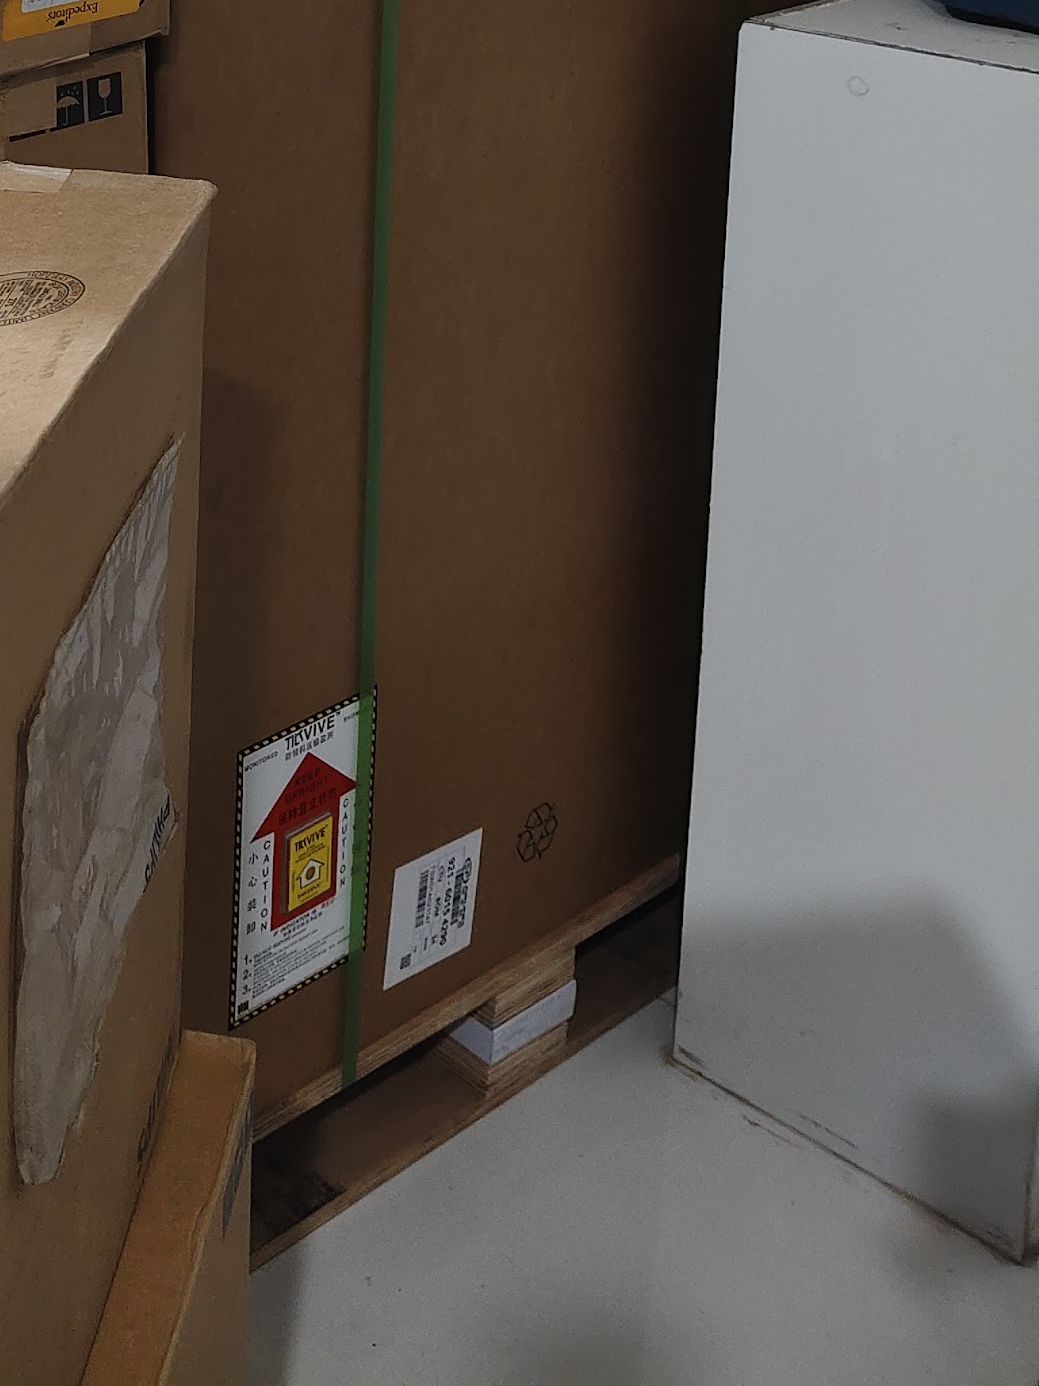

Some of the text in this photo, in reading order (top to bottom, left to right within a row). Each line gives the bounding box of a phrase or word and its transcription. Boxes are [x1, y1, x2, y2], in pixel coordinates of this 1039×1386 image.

[47, 1, 99, 23] Expeditors
[260, 840, 271, 932] CAUTION
[340, 798, 349, 887] CAUTION
